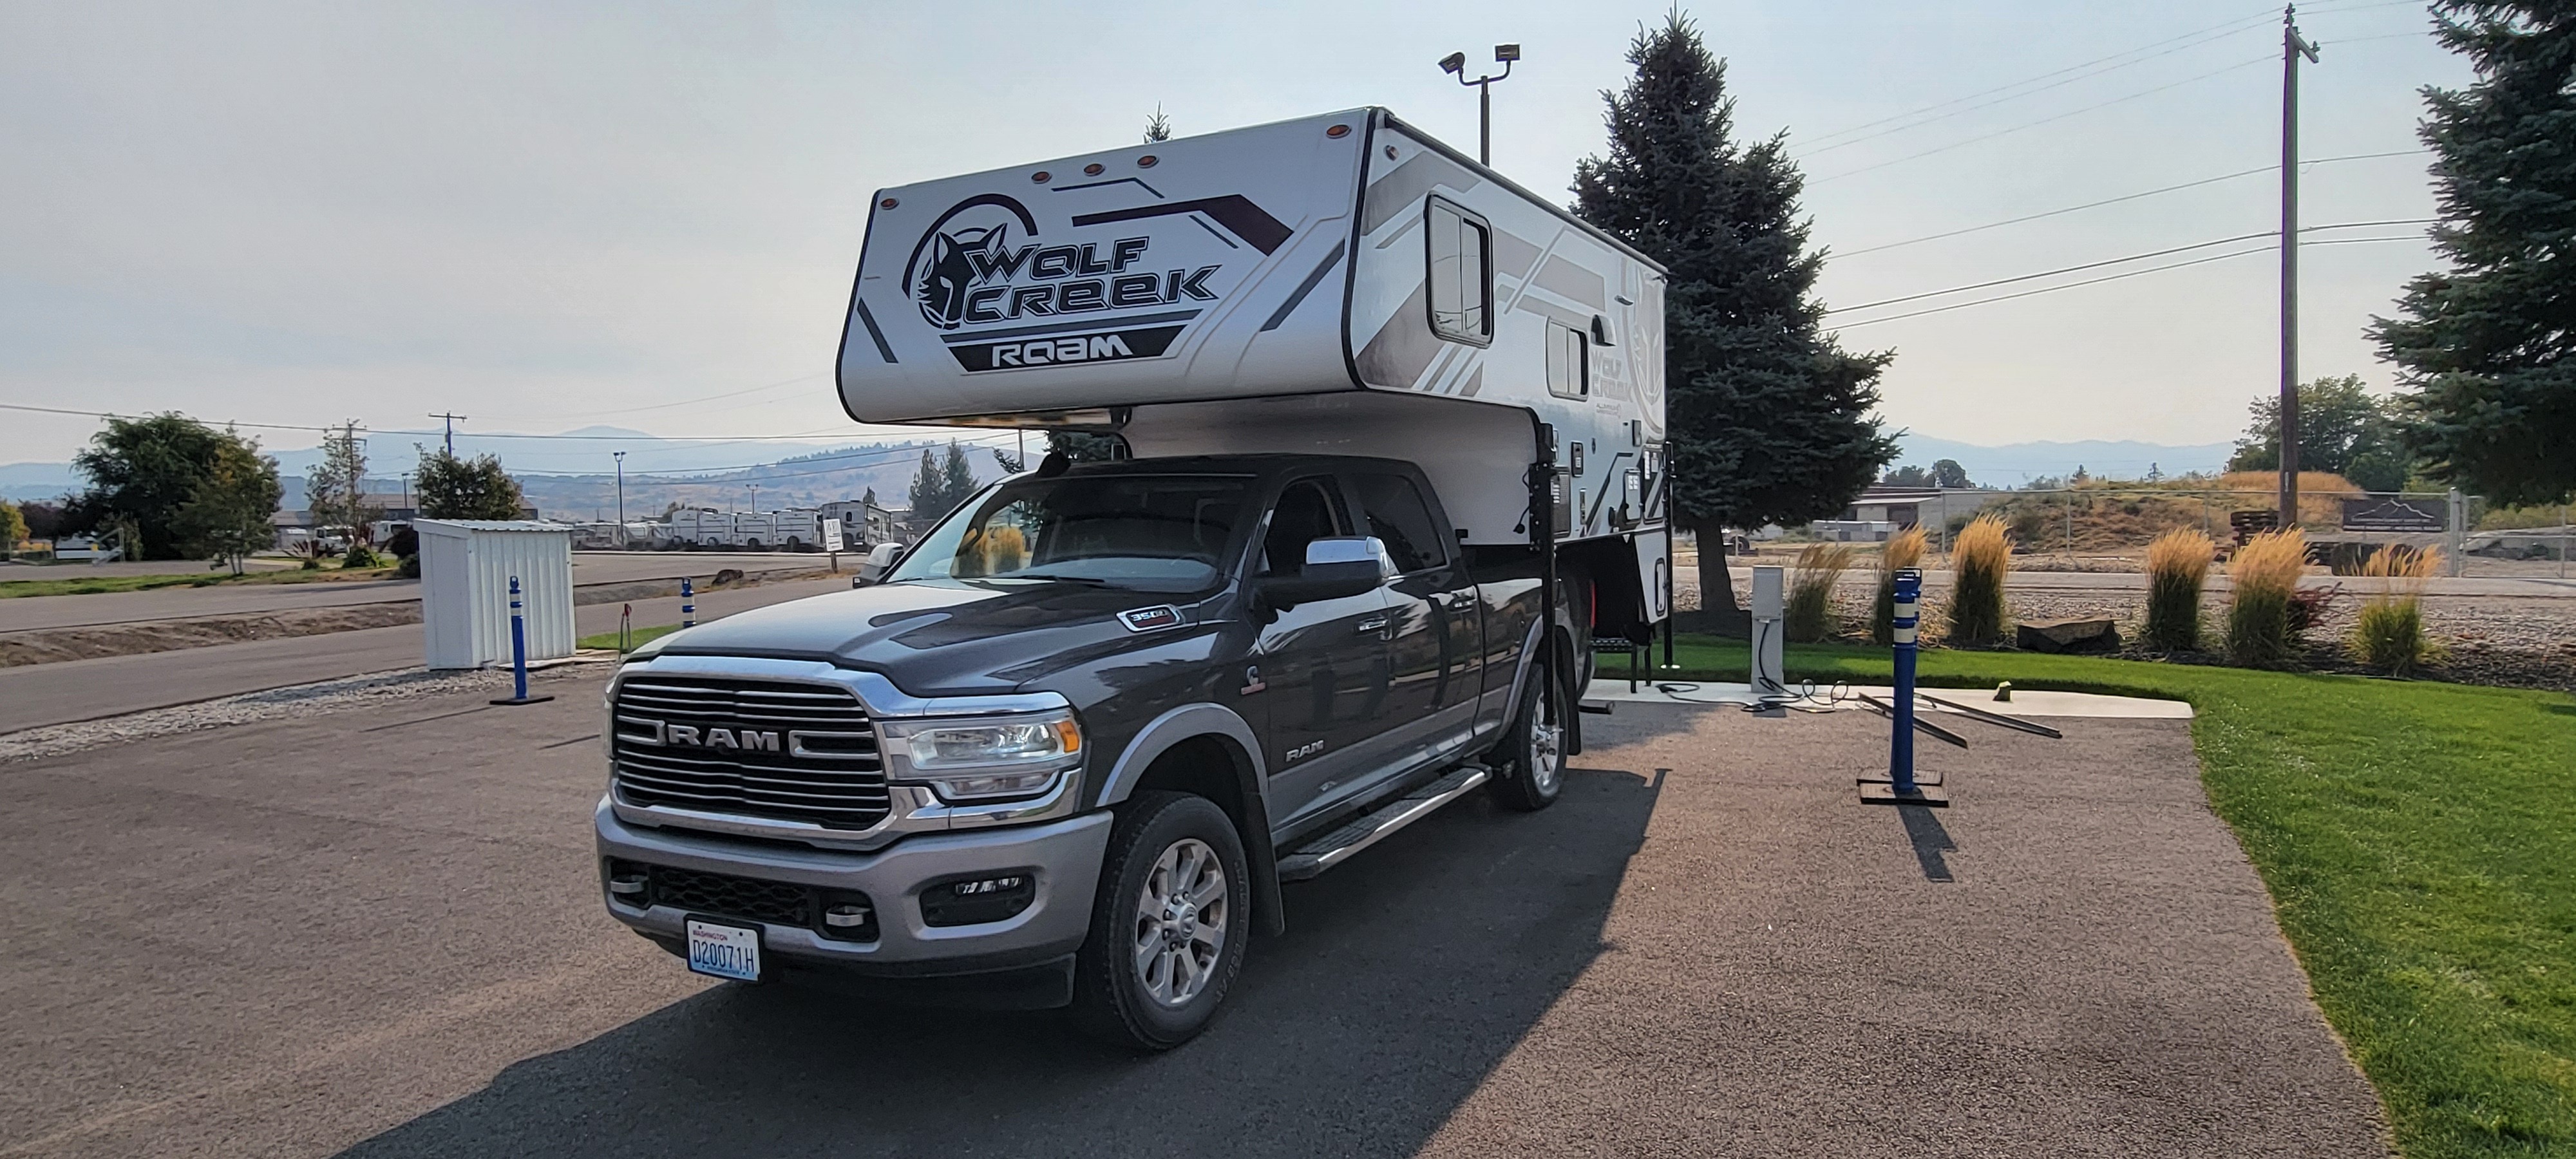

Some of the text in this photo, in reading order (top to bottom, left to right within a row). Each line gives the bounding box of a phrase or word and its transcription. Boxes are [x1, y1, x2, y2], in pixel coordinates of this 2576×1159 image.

[963, 236, 1150, 285] WOLF
[668, 724, 780, 752] RAM
[1286, 740, 1324, 762] RAM
[693, 939, 754, 973] D20071H
